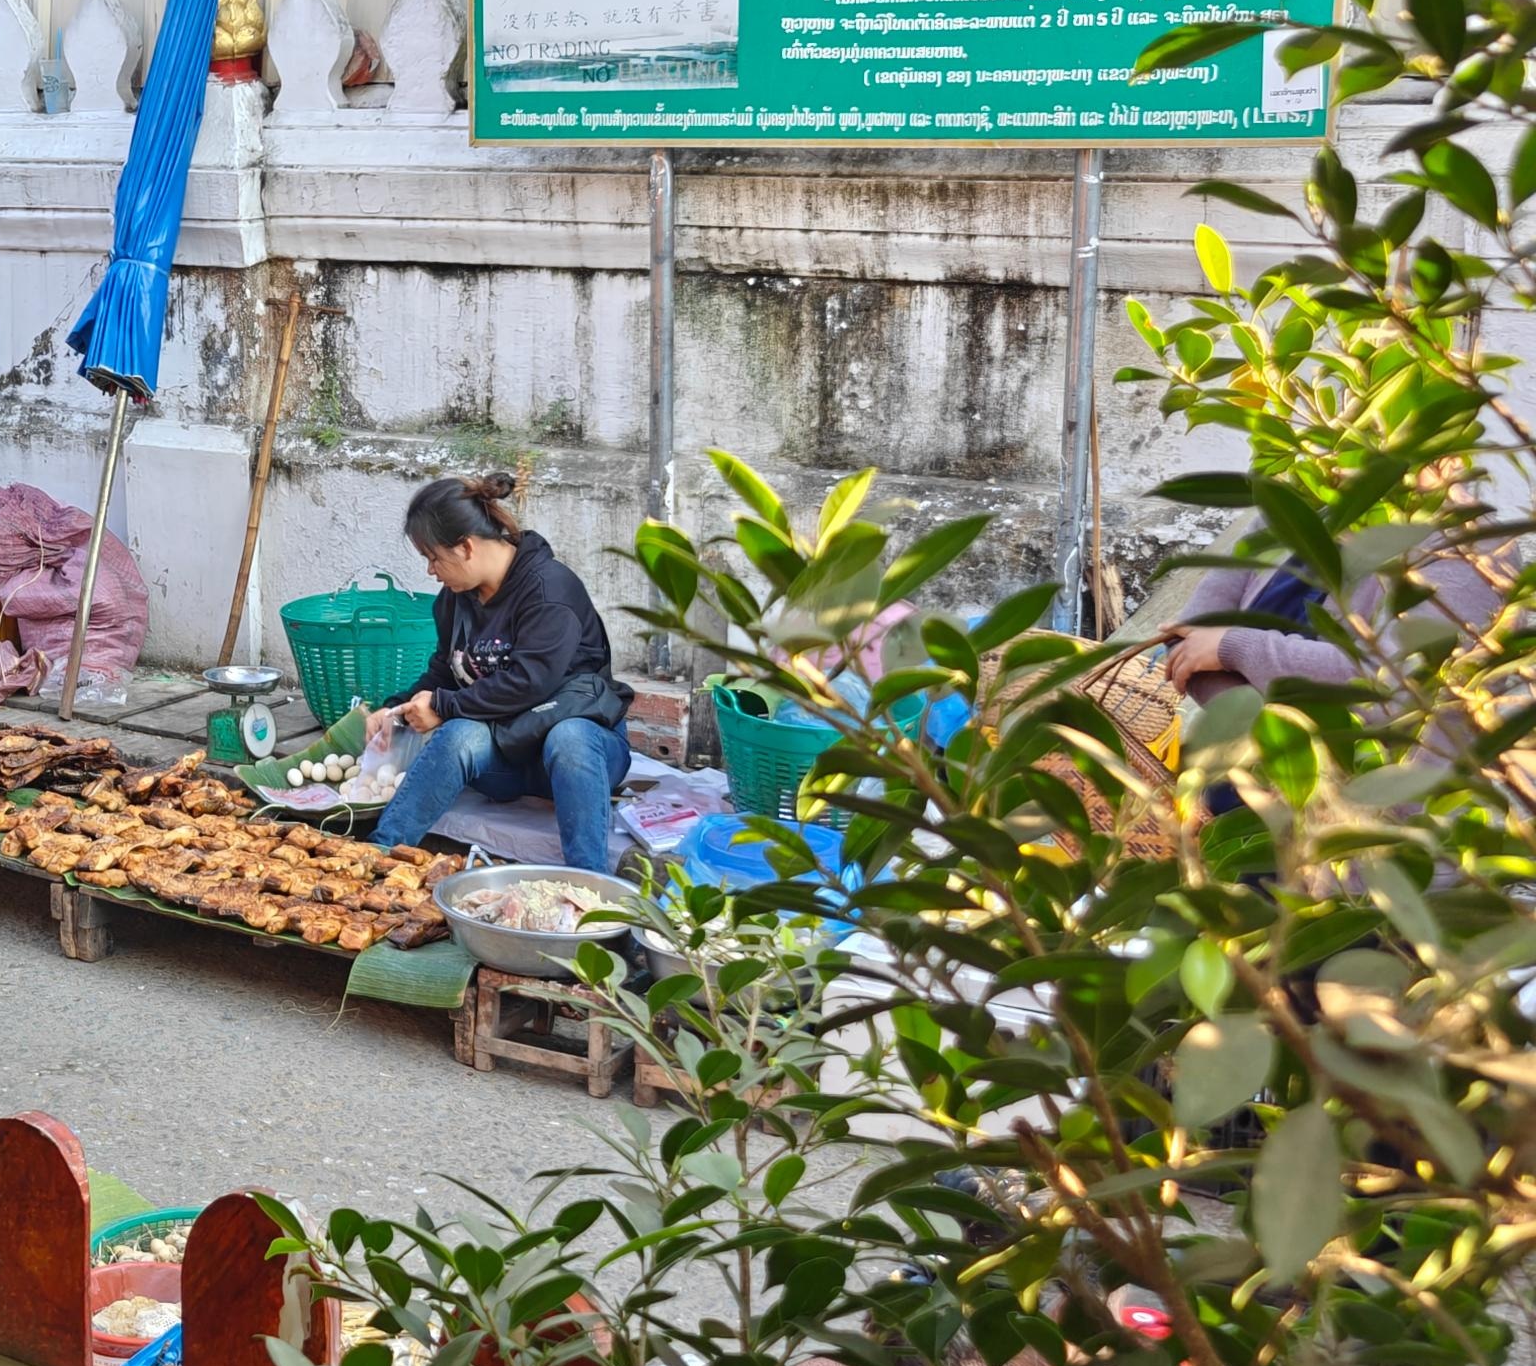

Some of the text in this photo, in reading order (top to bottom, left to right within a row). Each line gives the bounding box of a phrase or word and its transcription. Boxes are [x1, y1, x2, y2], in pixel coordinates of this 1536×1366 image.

[1040, 14, 1052, 28] 2
[1096, 12, 1108, 27] 5
[492, 39, 611, 60] NO TRADING
[582, 66, 611, 83] NO
